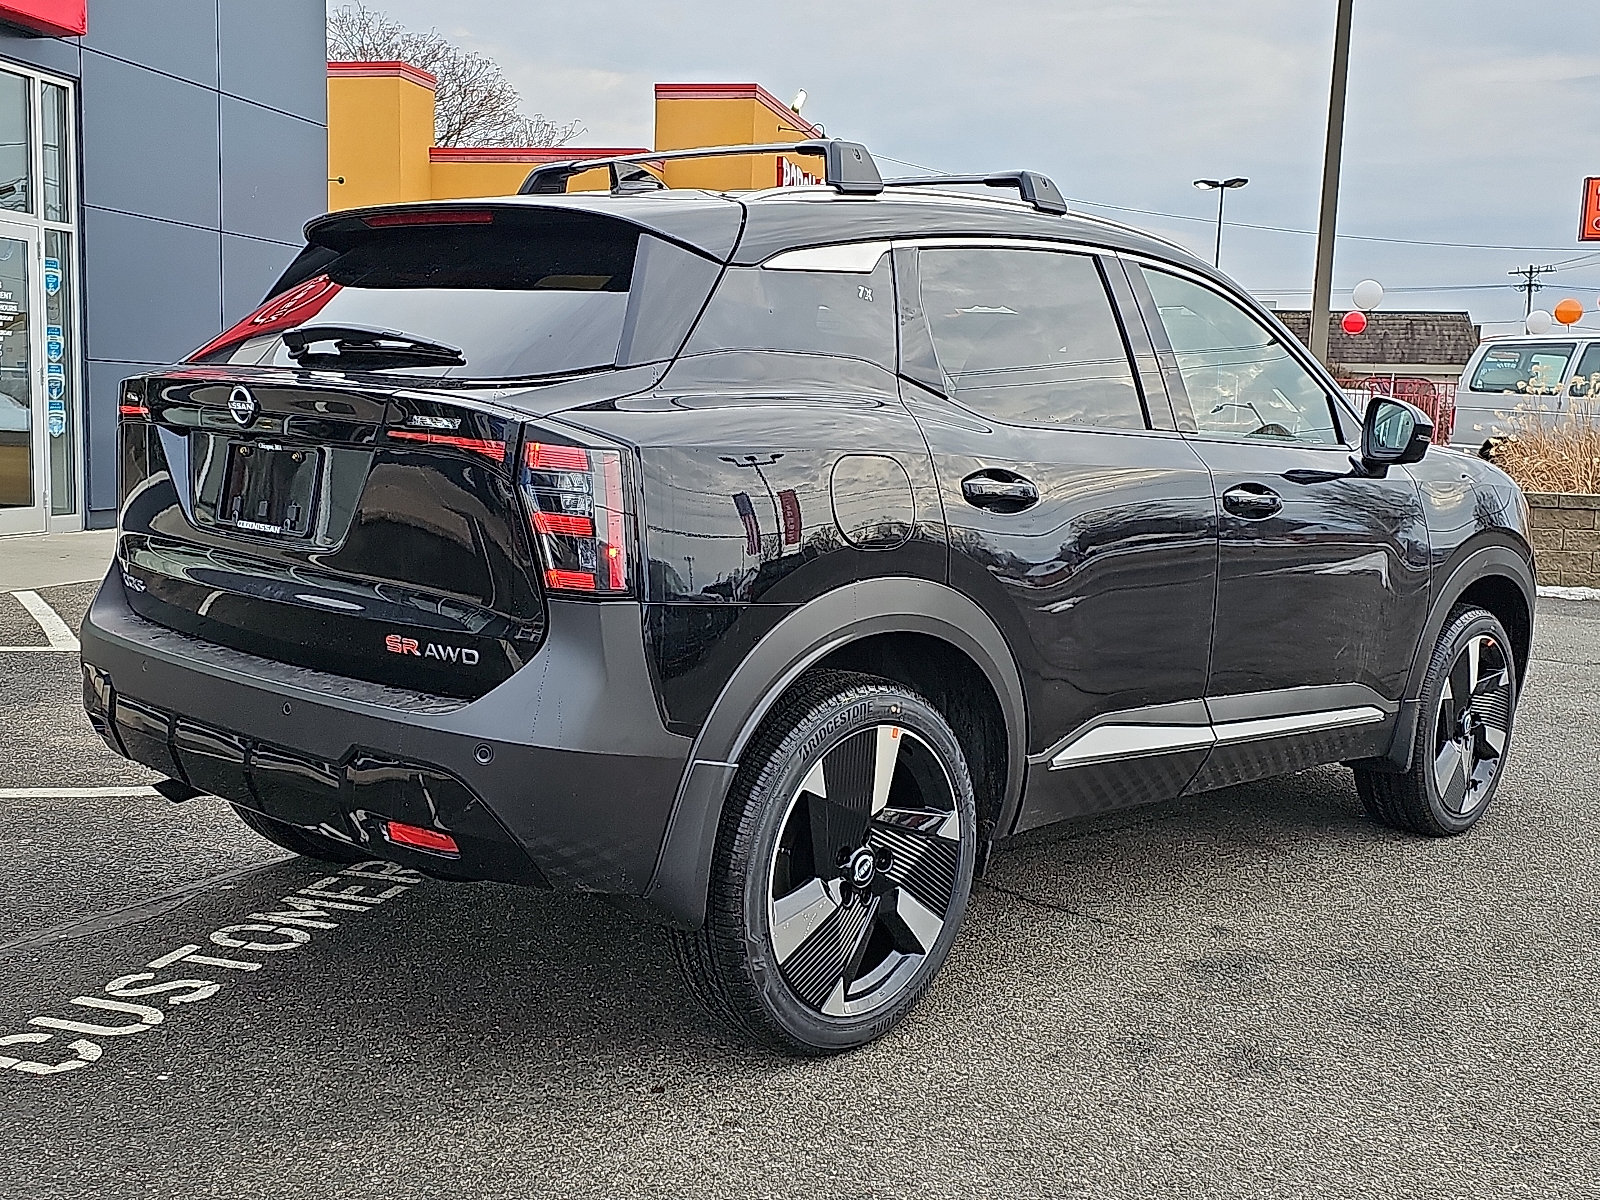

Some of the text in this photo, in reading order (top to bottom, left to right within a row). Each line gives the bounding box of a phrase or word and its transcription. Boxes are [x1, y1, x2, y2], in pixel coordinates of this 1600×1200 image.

[385, 634, 479, 665] SR AWD
[798, 700, 874, 762] BRIDGESTONE
[0, 860, 421, 1075] CUSTOMER
